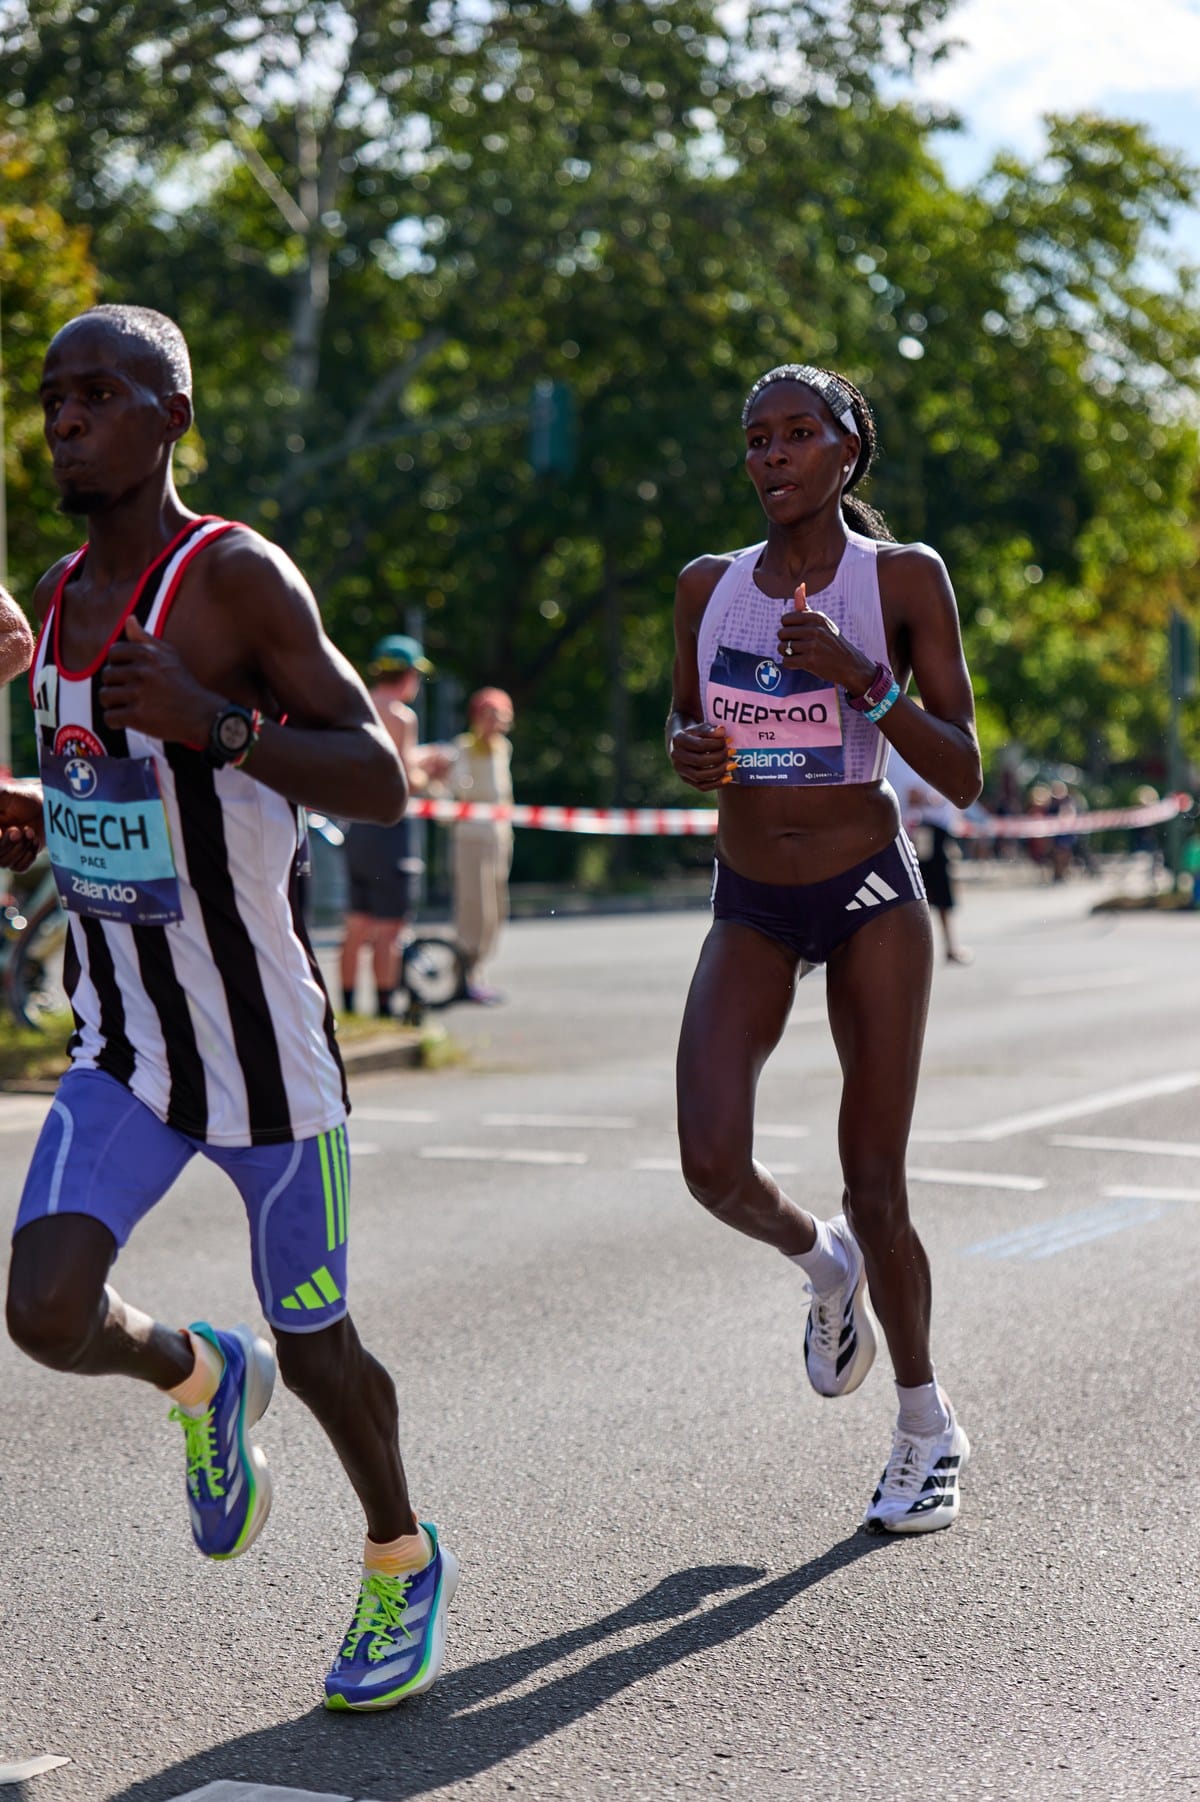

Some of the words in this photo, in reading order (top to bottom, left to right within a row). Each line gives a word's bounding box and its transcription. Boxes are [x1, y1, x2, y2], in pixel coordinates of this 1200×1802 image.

[712, 696, 828, 725] CHEPTOO
[758, 731, 776, 741] F12
[732, 750, 807, 768] zalando
[47, 800, 150, 851] KOECH
[80, 855, 107, 869] PACE
[71, 876, 137, 904] zalando
